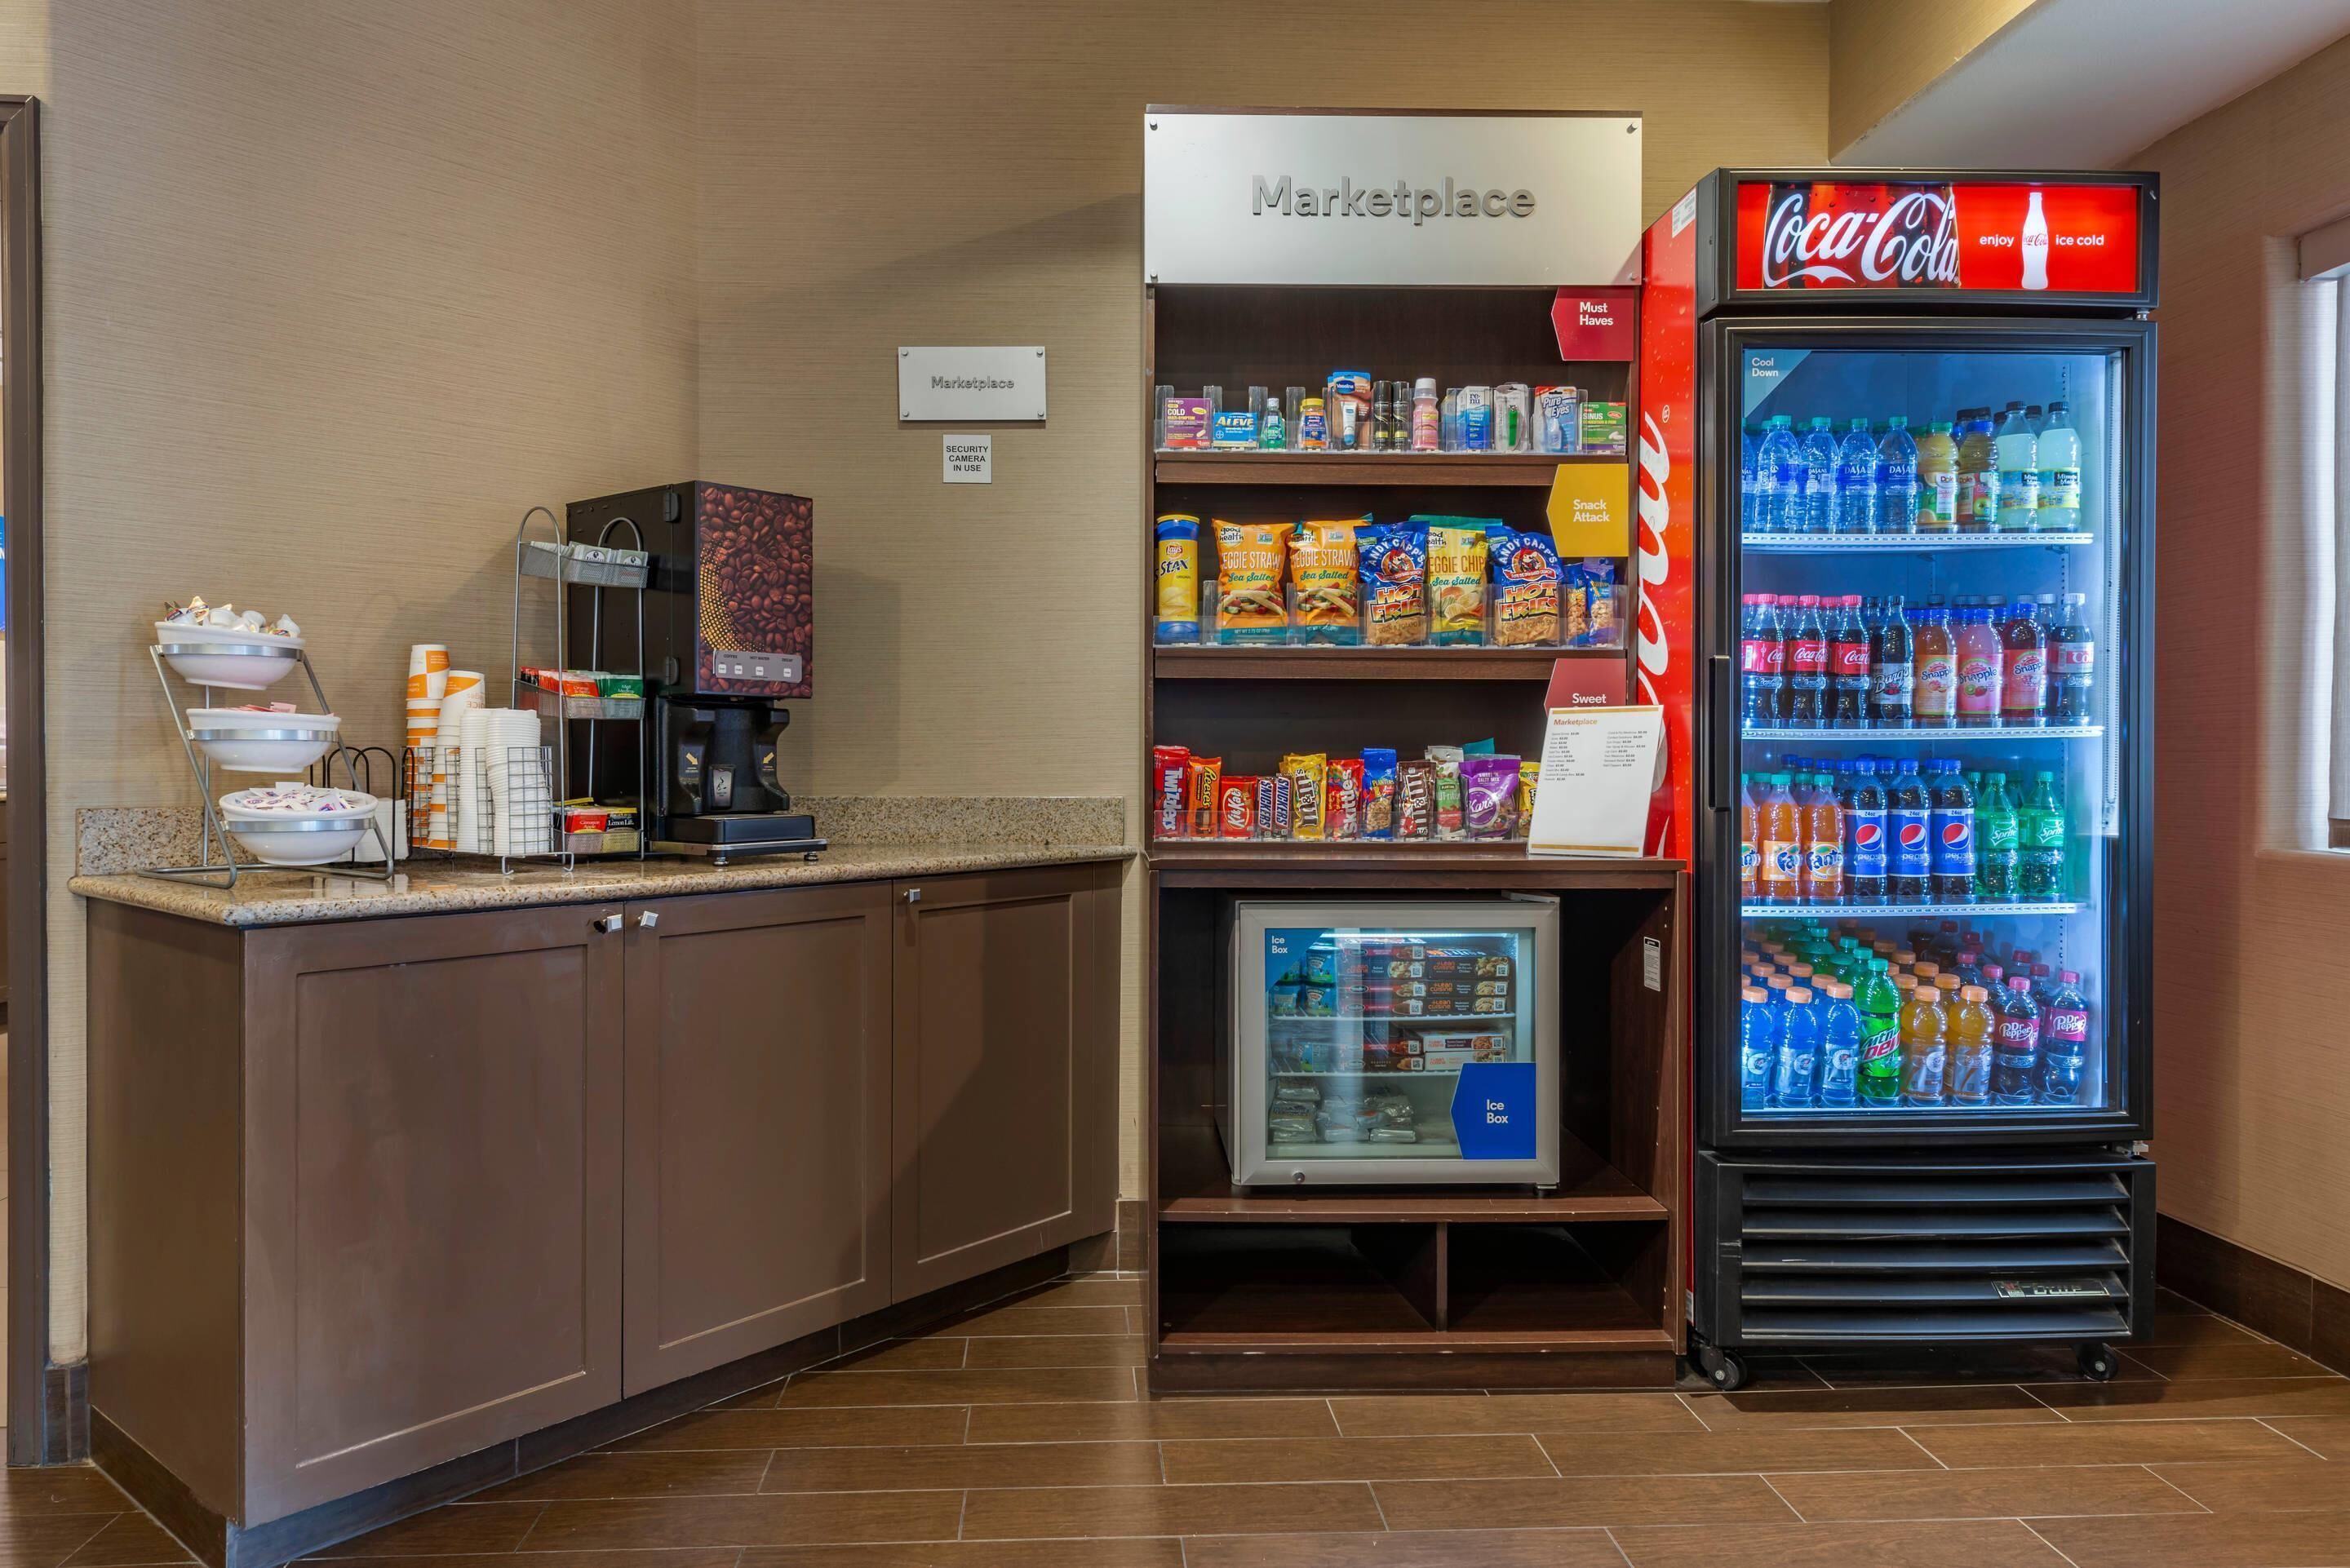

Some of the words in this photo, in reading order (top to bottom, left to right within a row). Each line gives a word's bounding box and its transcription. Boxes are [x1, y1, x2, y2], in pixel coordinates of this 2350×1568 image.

[1251, 175, 1536, 226] Marketplace
[1763, 193, 1958, 287] Coca-Cola
[1980, 234, 2014, 248] enjoy
[2055, 234, 2073, 246] ice
[2076, 234, 2104, 246] cold
[1580, 302, 1608, 314] Must
[1579, 315, 1614, 326] Haves
[1751, 357, 1775, 368] Cool
[1751, 369, 1780, 378] Down
[930, 375, 1014, 391] Marketplace
[1543, 396, 1563, 409] Pure
[1167, 408, 1186, 416] COLD
[1551, 405, 1570, 419] Eyes
[948, 454, 987, 463] CAMERA
[1845, 464, 1867, 476] DASA
[1889, 464, 1911, 475] DASA
[1572, 499, 1607, 510] Snack
[1572, 511, 1610, 522] Attack
[1221, 527, 1240, 535] good
[1428, 530, 1443, 538] ood
[1219, 533, 1244, 542] health
[1426, 536, 1447, 545] ealth
[1368, 542, 1390, 566] ANDY
[1391, 538, 1426, 563] CAPP'S
[1499, 538, 1521, 565] ANDY
[1523, 537, 1558, 564] CAPP'S
[1222, 551, 1248, 569] EGGIE
[1249, 551, 1281, 570] STRAW
[1428, 556, 1458, 574] EGGIE
[1461, 556, 1485, 574] CHIP
[1228, 572, 1244, 582] Sea
[1247, 572, 1275, 582] Salted
[1301, 570, 1317, 581] Sea
[1318, 569, 1350, 581] Salted
[1432, 577, 1451, 587] Sea
[1452, 575, 1482, 587] Salted
[1377, 582, 1423, 603] HOT
[1505, 582, 1559, 602] HOT
[1501, 597, 1559, 622] FRIES
[2015, 658, 2043, 675] Snapp
[1959, 667, 1998, 685] Snapple
[1572, 693, 1607, 704] Sweet
[1553, 718, 1598, 727] Marketplace
[1203, 766, 1217, 808] Reese's
[1259, 780, 1273, 829] SNICKERS
[1276, 777, 1289, 826] SNICKERS
[1341, 769, 1358, 834] Skittles
[1469, 797, 1494, 813] Kar's
[1741, 849, 1757, 868] ant
[1857, 853, 1882, 862] peps
[1902, 853, 1925, 862] peps
[1944, 853, 1968, 862] peps
[1271, 935, 1285, 944] Ice
[1271, 945, 1288, 954] Box
[2057, 1017, 2084, 1031] Pepp
[2066, 1014, 2079, 1024] Dr
[2002, 1023, 2031, 1039] Pepper
[2011, 1022, 2024, 1031] Dr
[1486, 1100, 1505, 1110] Ice
[1486, 1112, 1509, 1124] Box
